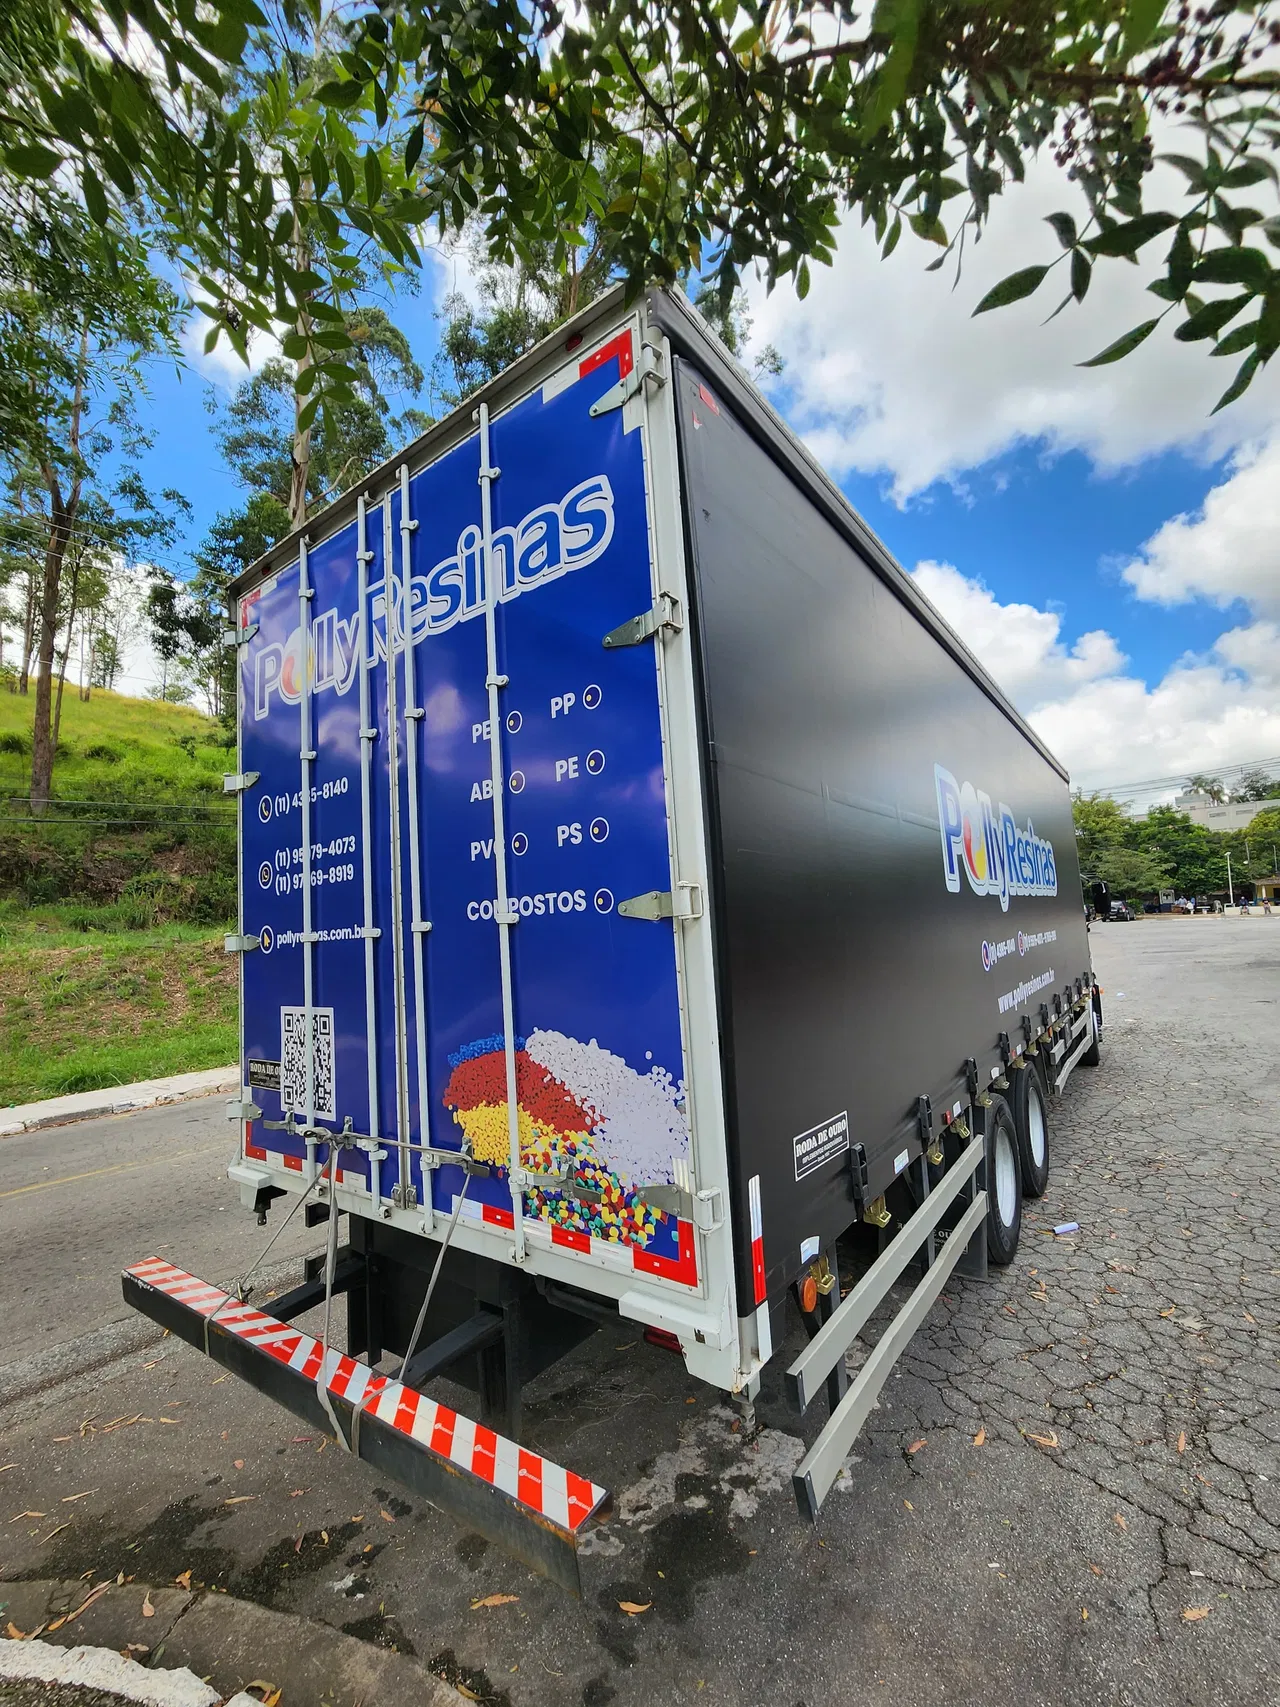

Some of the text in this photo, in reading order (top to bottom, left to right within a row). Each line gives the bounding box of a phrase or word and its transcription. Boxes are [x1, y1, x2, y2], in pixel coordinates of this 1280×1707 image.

[551, 692, 576, 719] PP
[472, 716, 500, 744] PE
[555, 756, 580, 782] PE
[275, 777, 348, 817] (11) 435-8140
[470, 777, 503, 802] AB
[557, 822, 583, 847] PS
[275, 835, 356, 871] (11) 9579-4073
[470, 839, 505, 862] PV
[275, 863, 354, 896] (11) 9769-8919
[796, 1135, 818, 1158] RODA
[818, 1129, 829, 1145] DE
[828, 1119, 847, 1139] OURO
